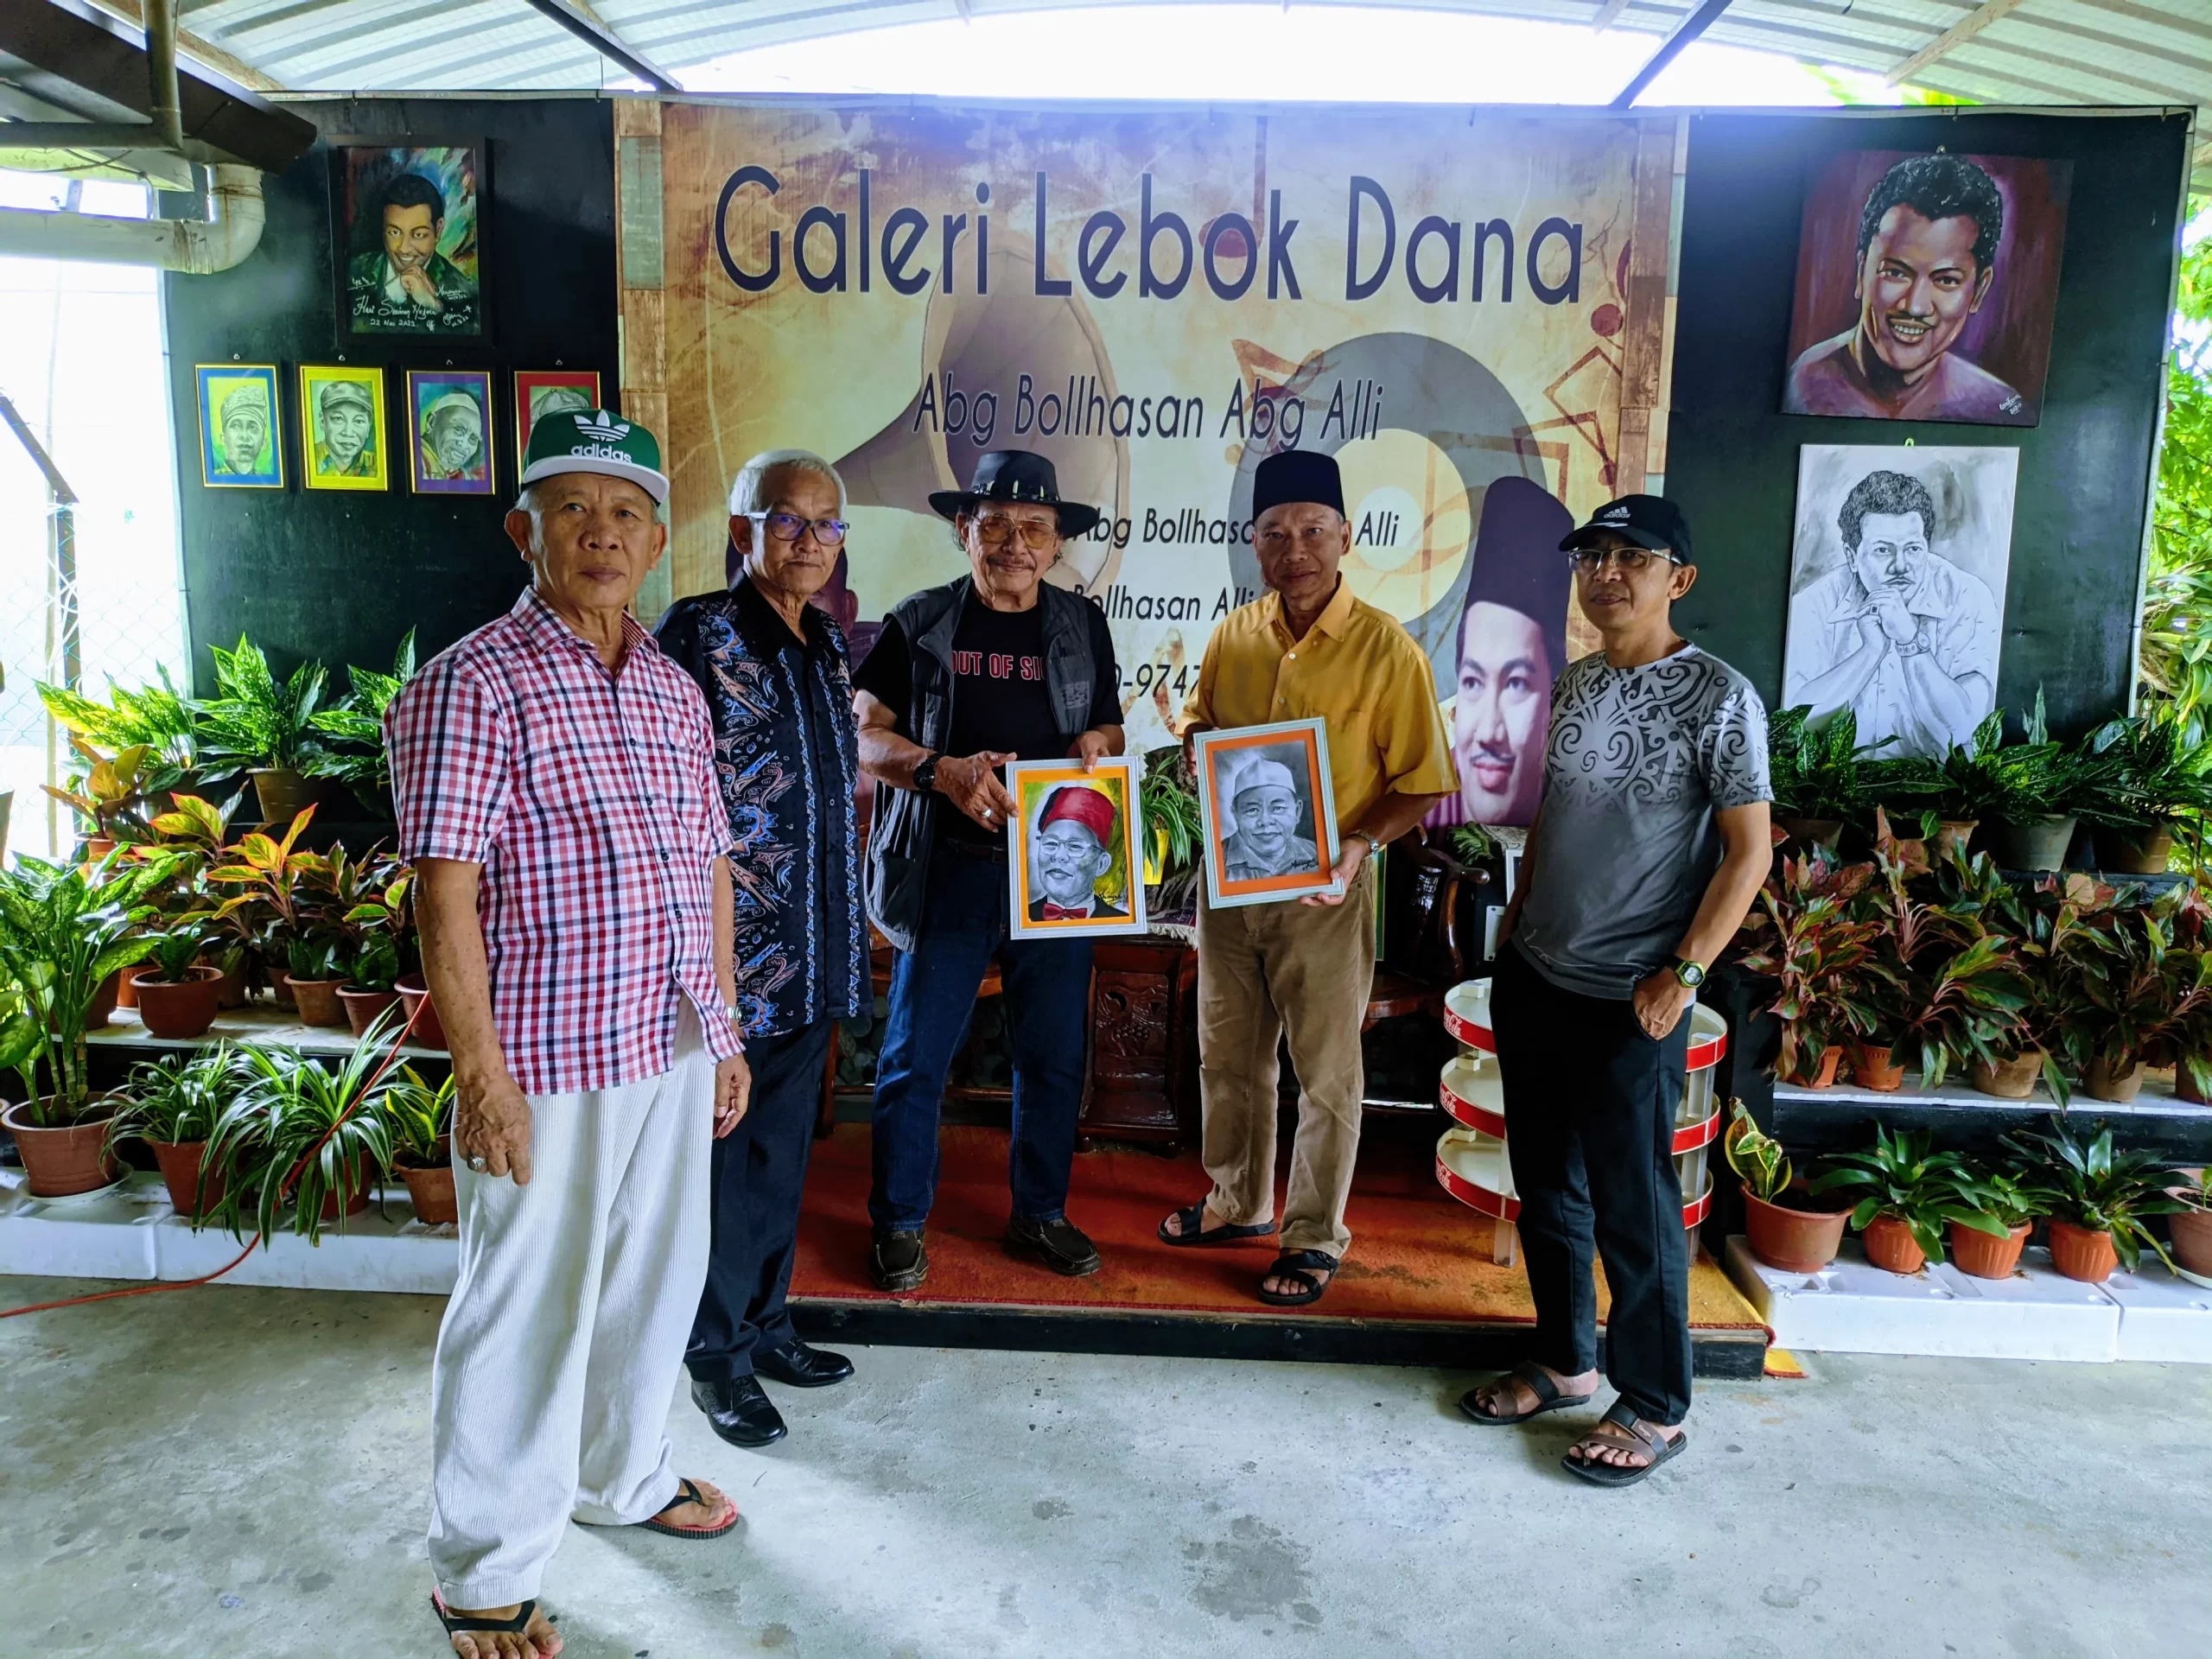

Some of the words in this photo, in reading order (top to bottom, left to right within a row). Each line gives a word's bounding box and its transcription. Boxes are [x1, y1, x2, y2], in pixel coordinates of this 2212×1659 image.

[715, 165, 991, 296] Galeri
[1034, 171, 1303, 301] Lebok
[1345, 175, 1584, 305] Dana
[913, 372, 997, 447] Abg
[1014, 372, 1204, 438] Bollhasan
[1219, 378, 1306, 452] Abg
[1319, 379, 1383, 440] Alli
[570, 442, 632, 464] adidas
[1073, 507, 1132, 549] bg
[1142, 507, 1254, 544] Bollhasa
[1354, 511, 1400, 547] Alli
[989, 653, 1014, 679] OF
